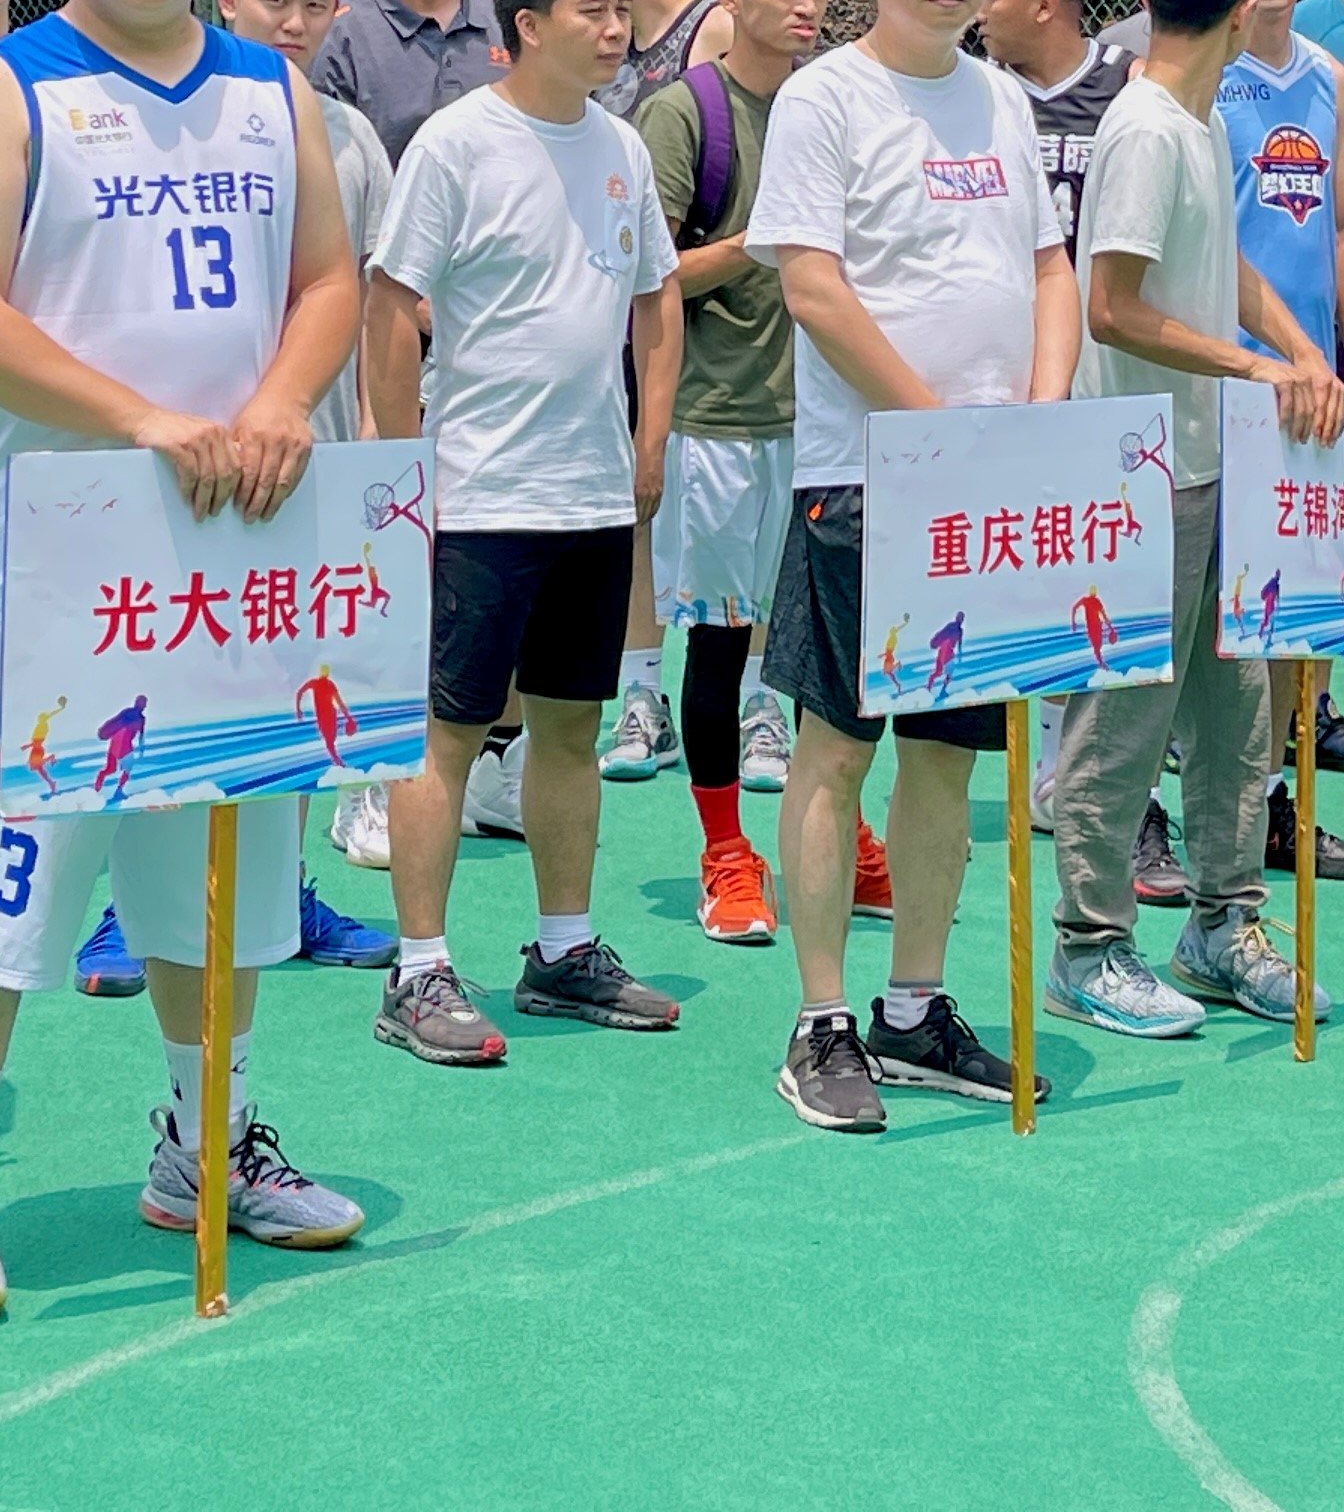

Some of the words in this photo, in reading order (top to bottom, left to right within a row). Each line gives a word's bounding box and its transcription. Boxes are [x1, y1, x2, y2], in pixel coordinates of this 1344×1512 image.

[93, 171, 274, 220] 光大银行
[166, 225, 237, 310] 13
[927, 500, 1124, 578] 重庆银行
[93, 563, 366, 655] 光大银行
